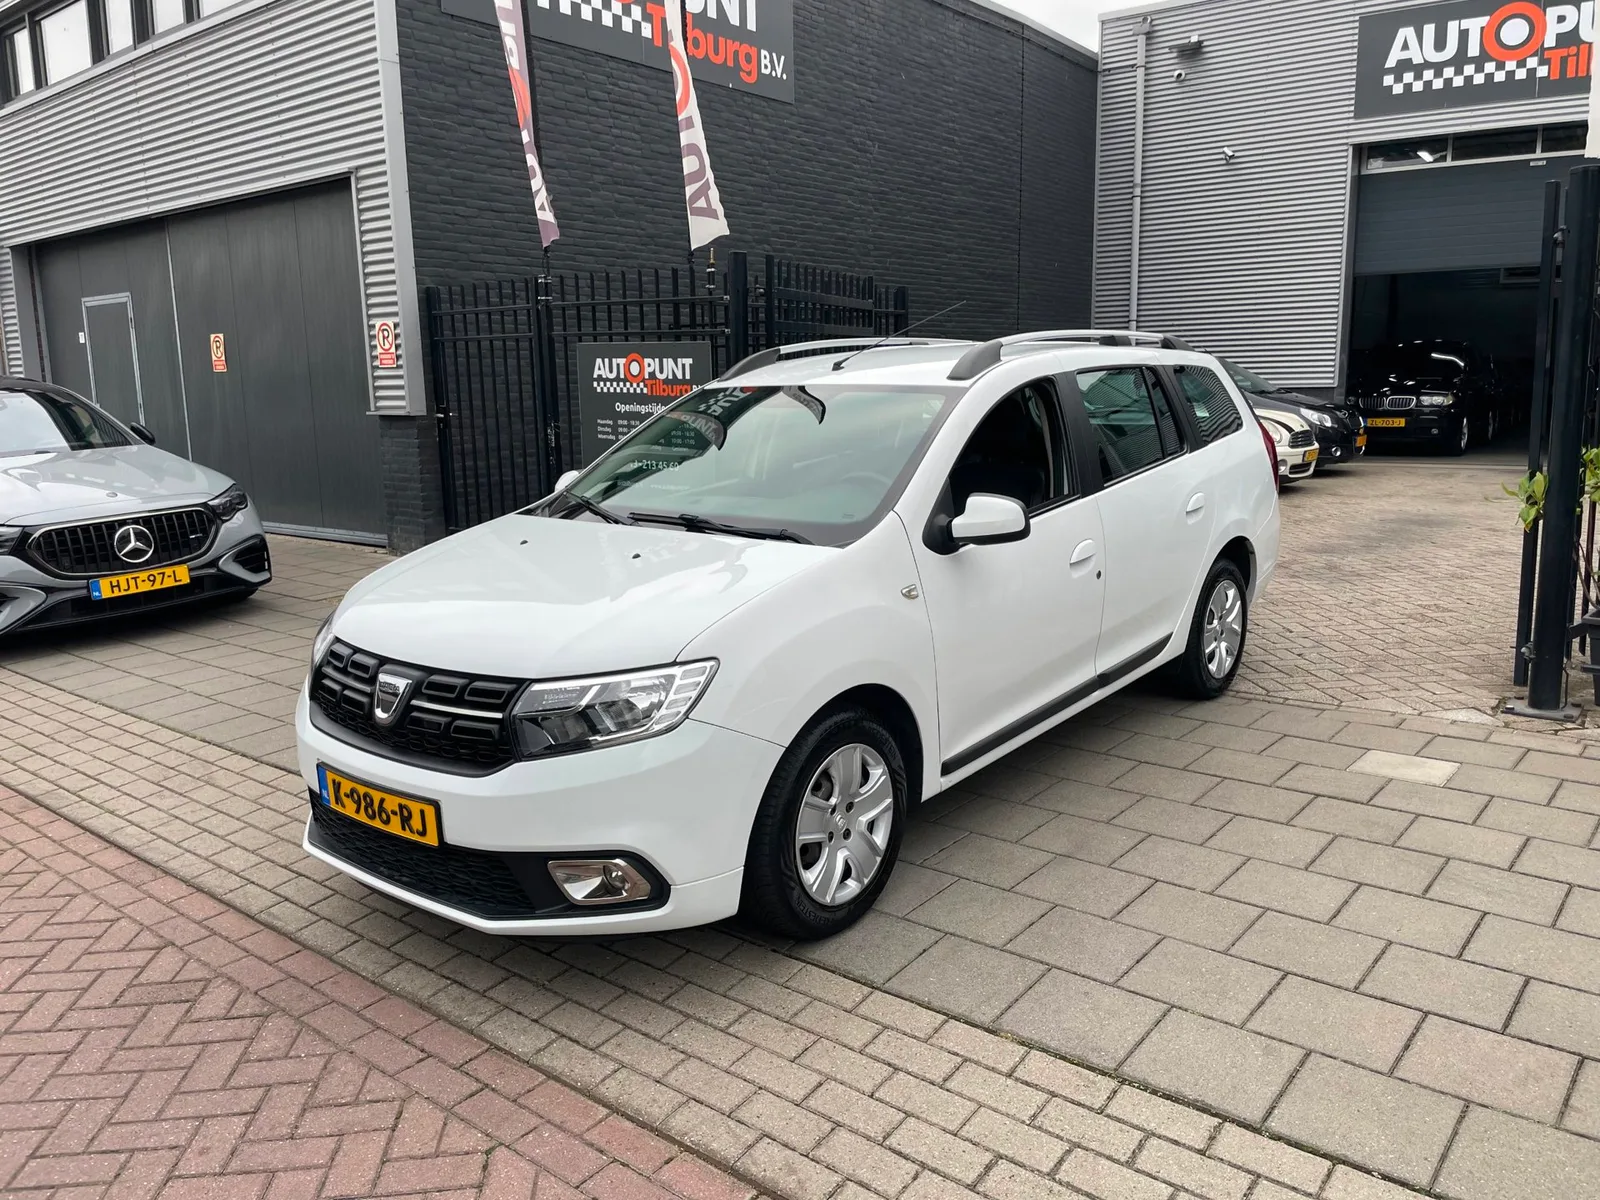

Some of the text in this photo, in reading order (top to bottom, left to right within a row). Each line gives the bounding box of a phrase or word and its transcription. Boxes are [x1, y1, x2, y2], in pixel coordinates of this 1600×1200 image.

[646, 2, 758, 84] Tburg
[760, 48, 787, 81] B.V.
[1544, 43, 1592, 80] Til
[593, 352, 693, 384] AUTOPUNT
[109, 569, 182, 594] HJT-97-L
[331, 778, 428, 837] K-986-RJ
